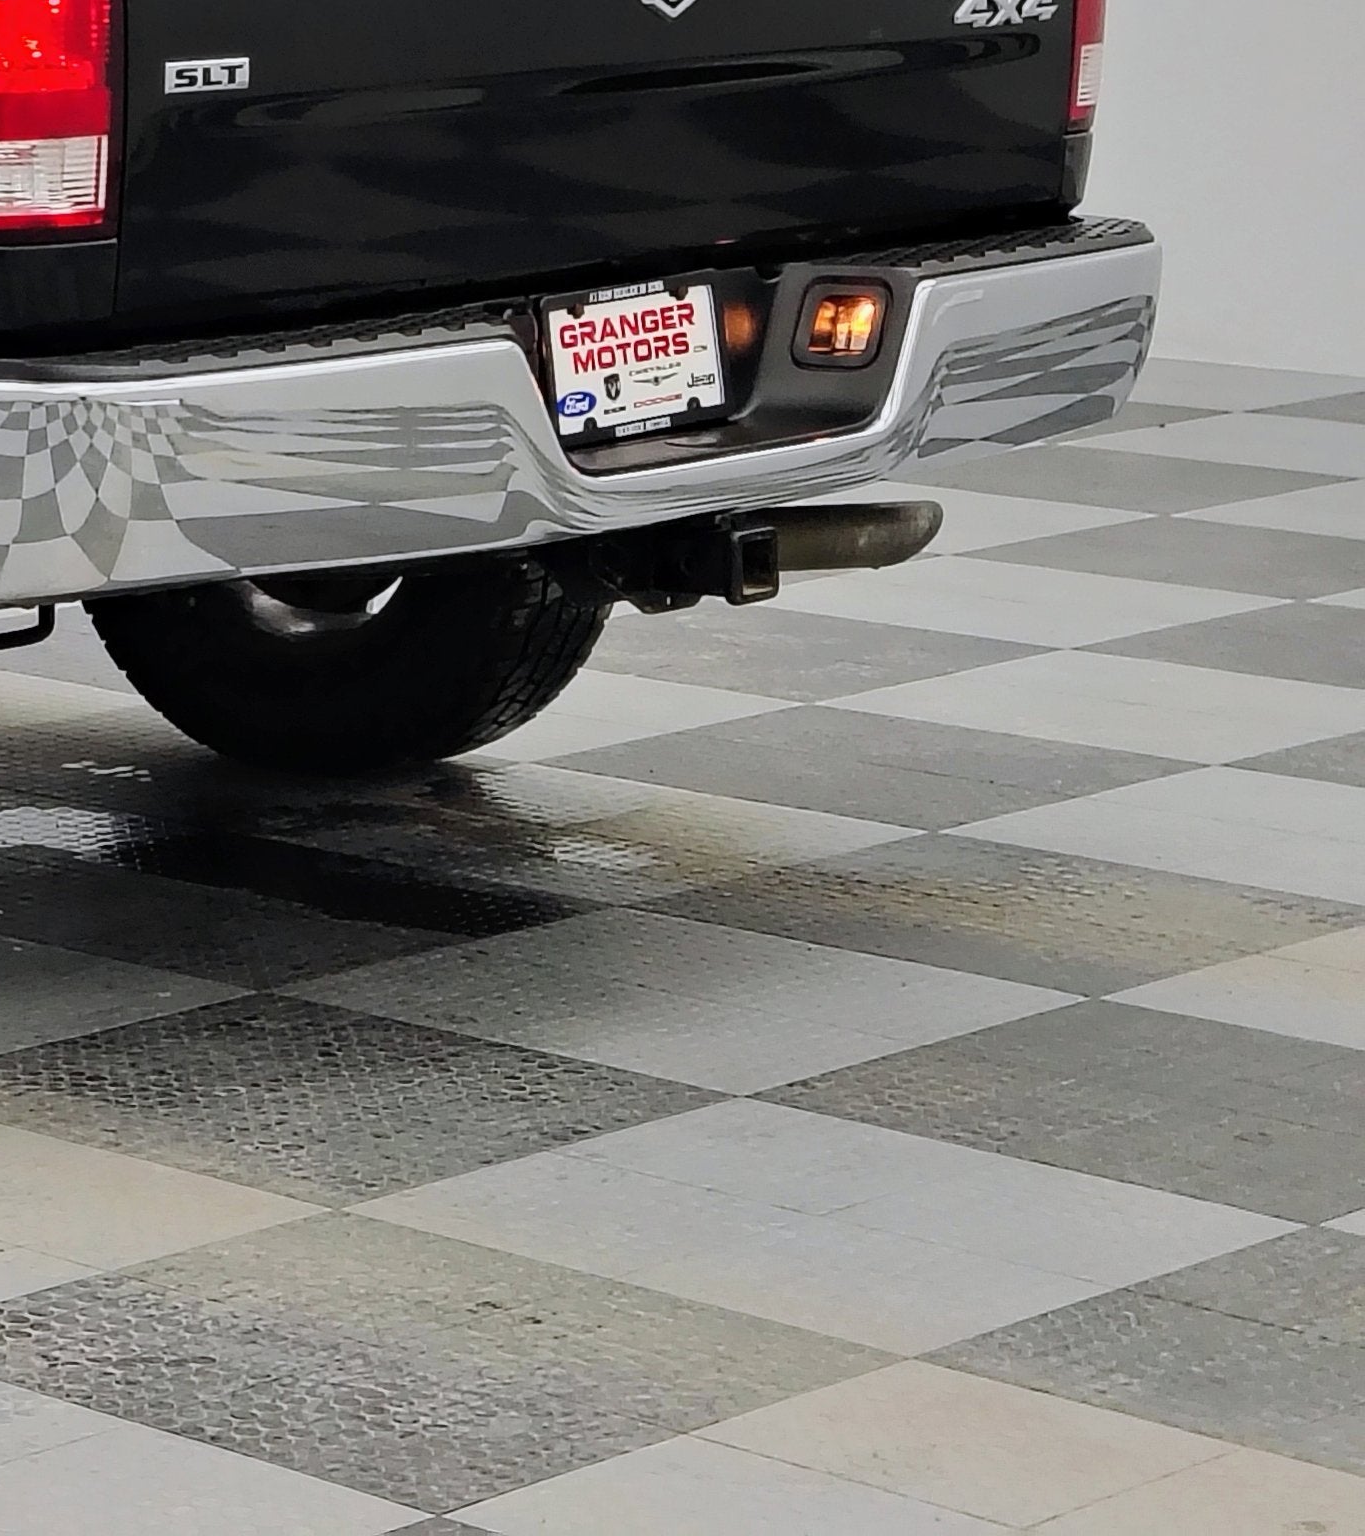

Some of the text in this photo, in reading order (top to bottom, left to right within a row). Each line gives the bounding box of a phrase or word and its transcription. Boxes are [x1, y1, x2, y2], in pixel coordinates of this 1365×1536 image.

[174, 64, 244, 88] SLT
[560, 303, 695, 349] GRANGER
[573, 332, 690, 375] MOTORS
